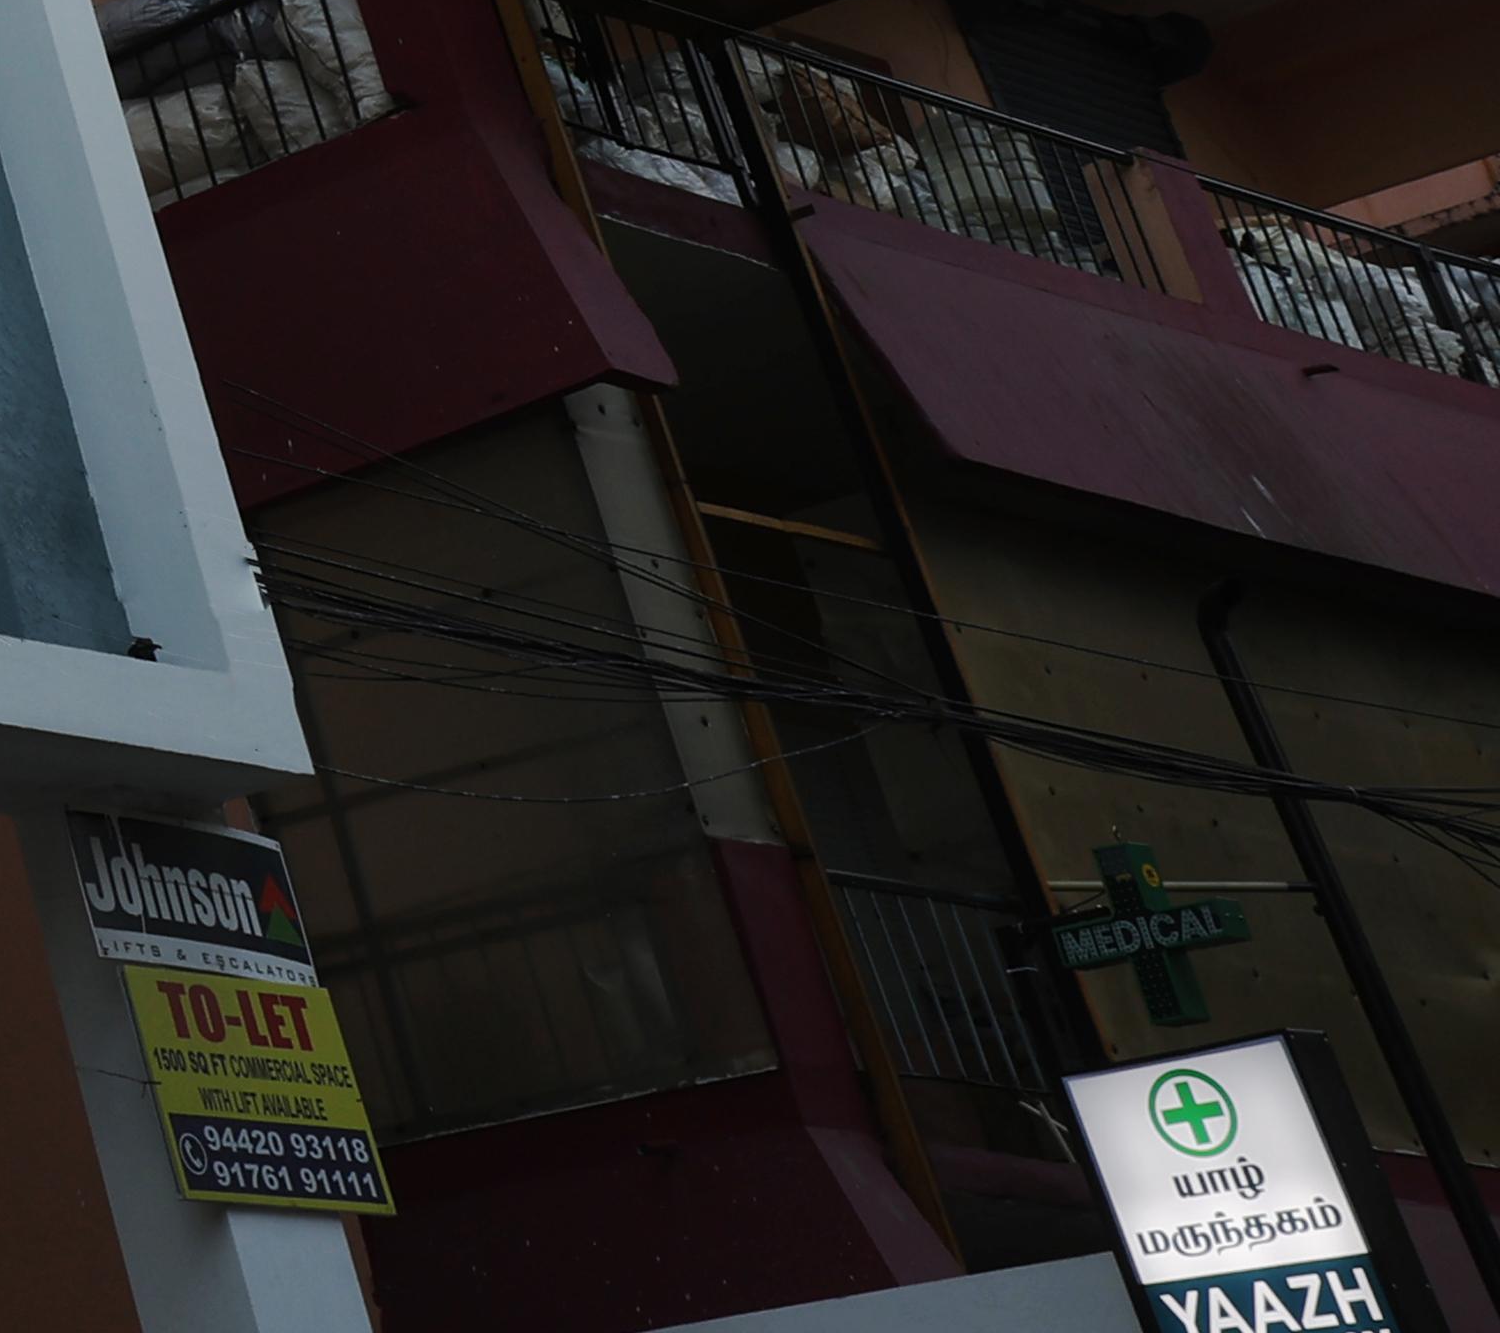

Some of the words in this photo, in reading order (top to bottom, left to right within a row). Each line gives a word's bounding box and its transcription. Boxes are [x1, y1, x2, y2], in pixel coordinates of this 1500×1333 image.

[86, 837, 263, 937] Johnson
[1061, 906, 1223, 956] MEDICAL
[101, 939, 161, 957] LIFTS
[177, 949, 188, 961] &
[202, 951, 316, 987] ESCALATORS
[157, 981, 314, 1051] TO-LET
[152, 1048, 187, 1073] 1500
[189, 1053, 209, 1076] SQ
[210, 1056, 227, 1077] FT
[230, 1056, 309, 1086] COMMERCIAL
[312, 1064, 352, 1088] SPACE
[198, 1088, 232, 1111] WITH
[234, 1092, 260, 1114] LIFT
[262, 1095, 327, 1122] AVAILABLE
[204, 1125, 284, 1157] 94420
[291, 1132, 370, 1163] 93118
[213, 1160, 293, 1192] 91761
[302, 1167, 378, 1198] 91111
[1173, 1157, 1264, 1199] யாழ்
[1137, 1198, 1342, 1257] மருந்தகம்
[1160, 1267, 1384, 1333] YAAZH
